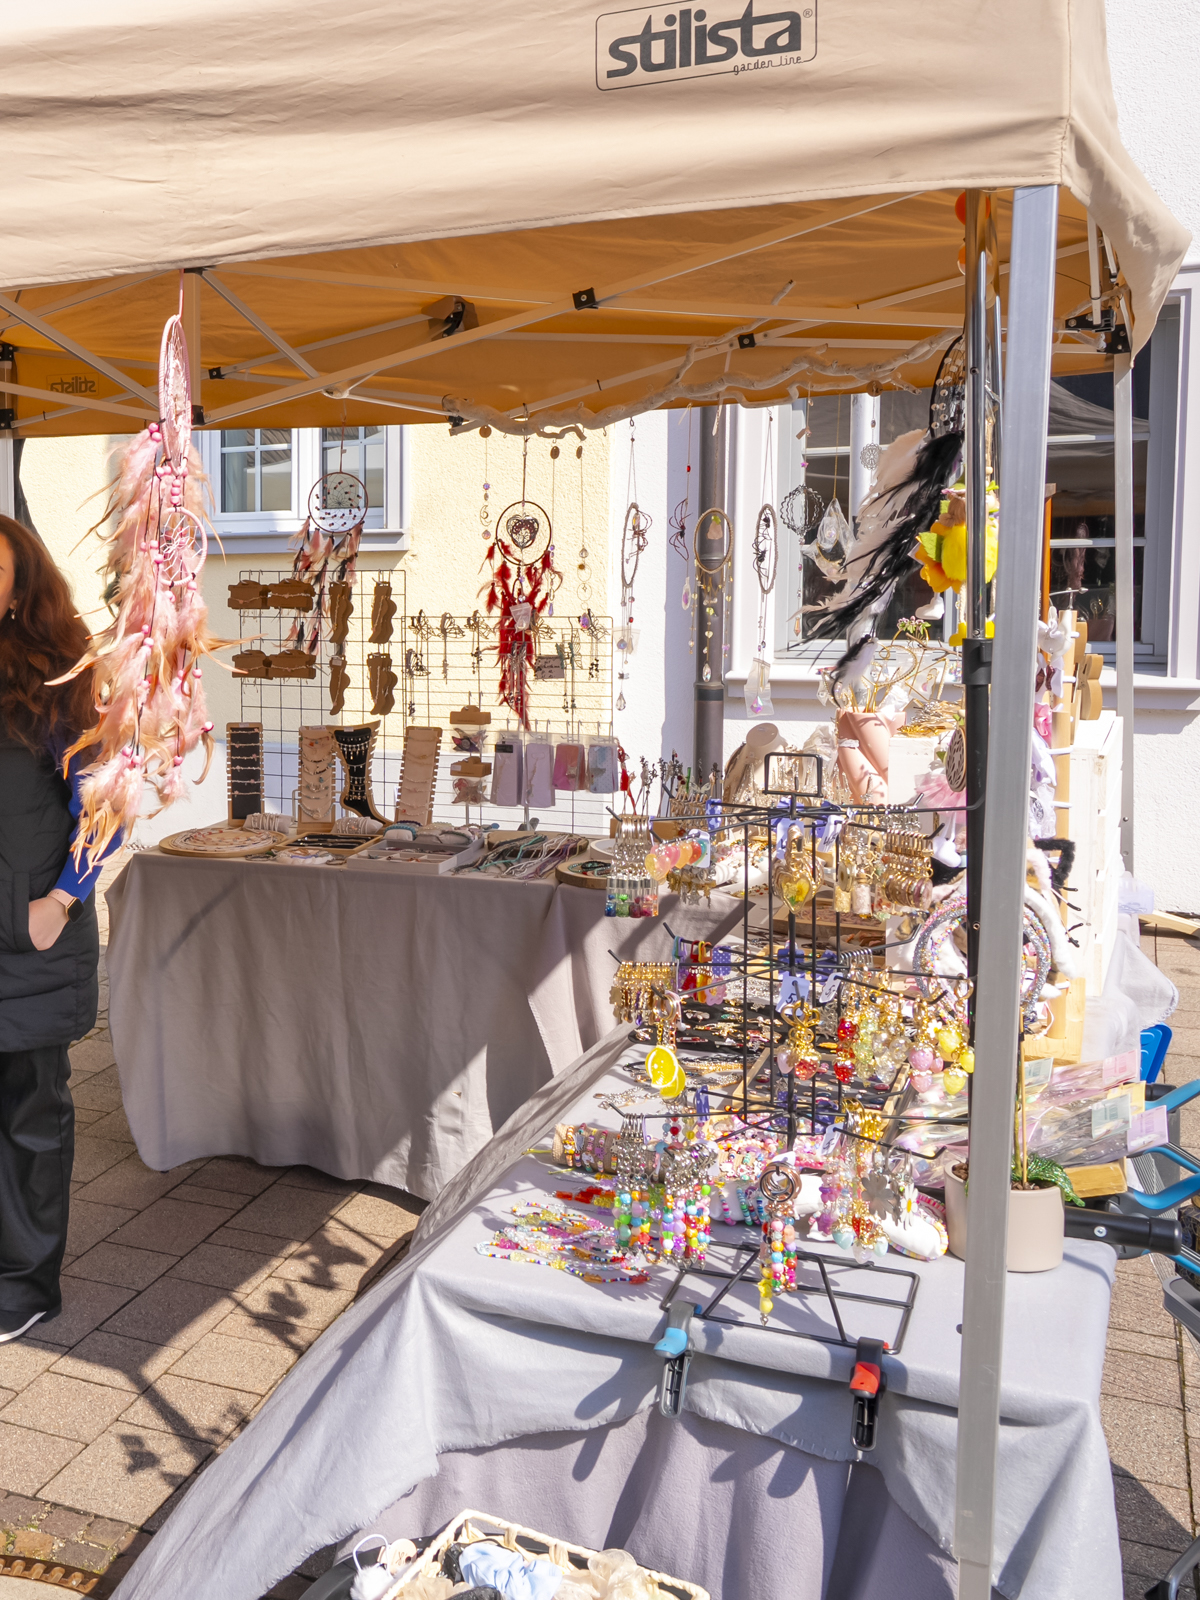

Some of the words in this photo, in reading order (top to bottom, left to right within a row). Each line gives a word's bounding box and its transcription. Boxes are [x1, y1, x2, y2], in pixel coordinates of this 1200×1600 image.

[606, 1, 801, 79] stilista
[733, 59, 774, 75] garden
[779, 55, 803, 69] line
